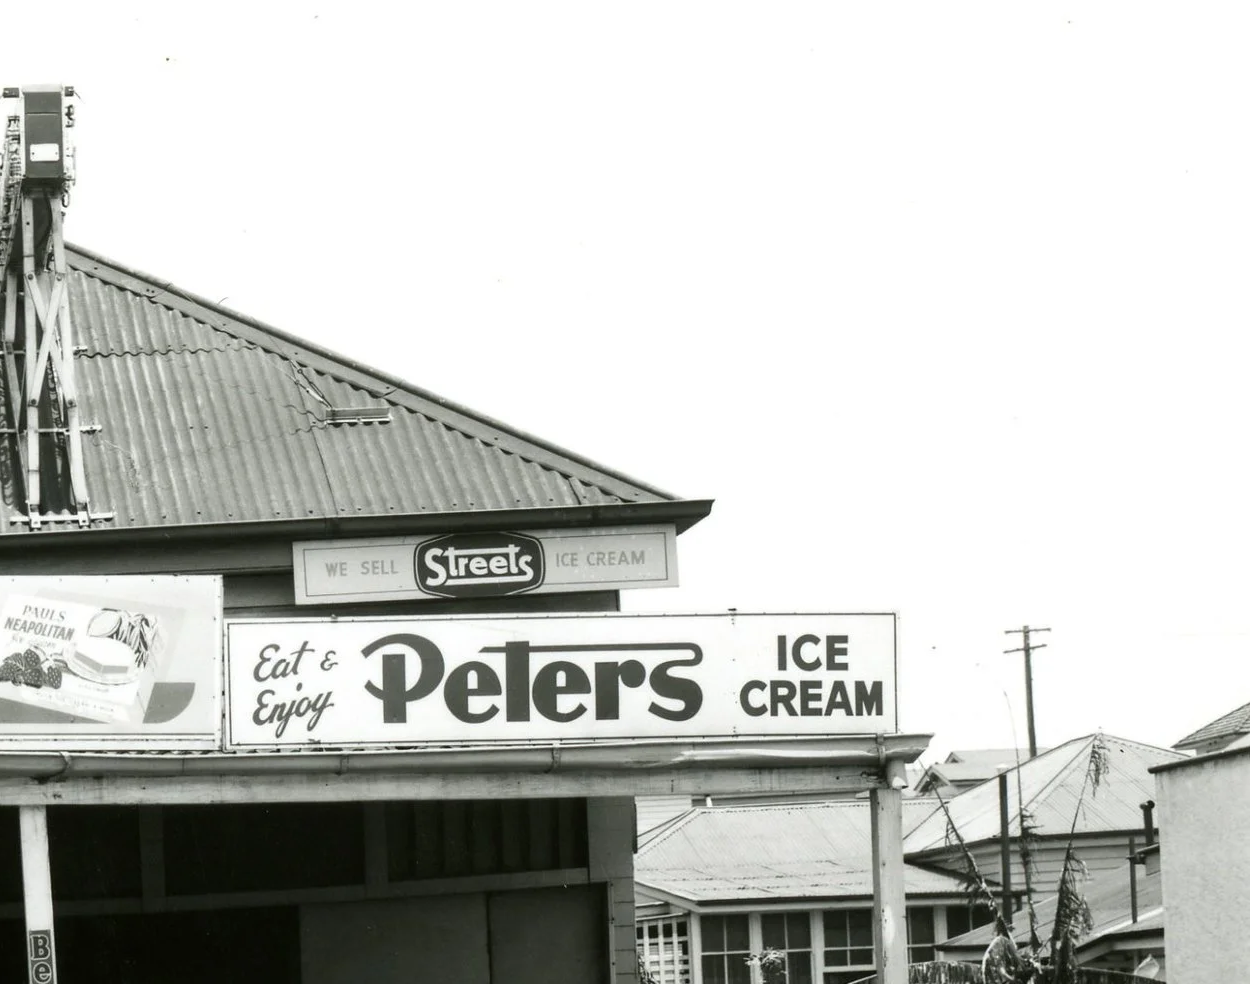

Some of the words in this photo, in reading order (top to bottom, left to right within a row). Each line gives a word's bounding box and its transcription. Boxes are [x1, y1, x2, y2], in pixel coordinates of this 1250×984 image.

[324, 561, 348, 578] WE
[360, 559, 399, 576] SELL
[424, 544, 535, 587] Streets
[555, 552, 579, 568] ICE
[586, 551, 646, 567] CREAM
[3, 616, 76, 642] NEAPOLITAN
[22, 604, 67, 622] PAULS
[252, 640, 315, 683] Eat
[319, 650, 339, 672] &
[776, 634, 849, 672] ICE
[360, 632, 704, 725] Peters
[739, 678, 884, 718] CREAM
[252, 682, 335, 739] Enjoy
